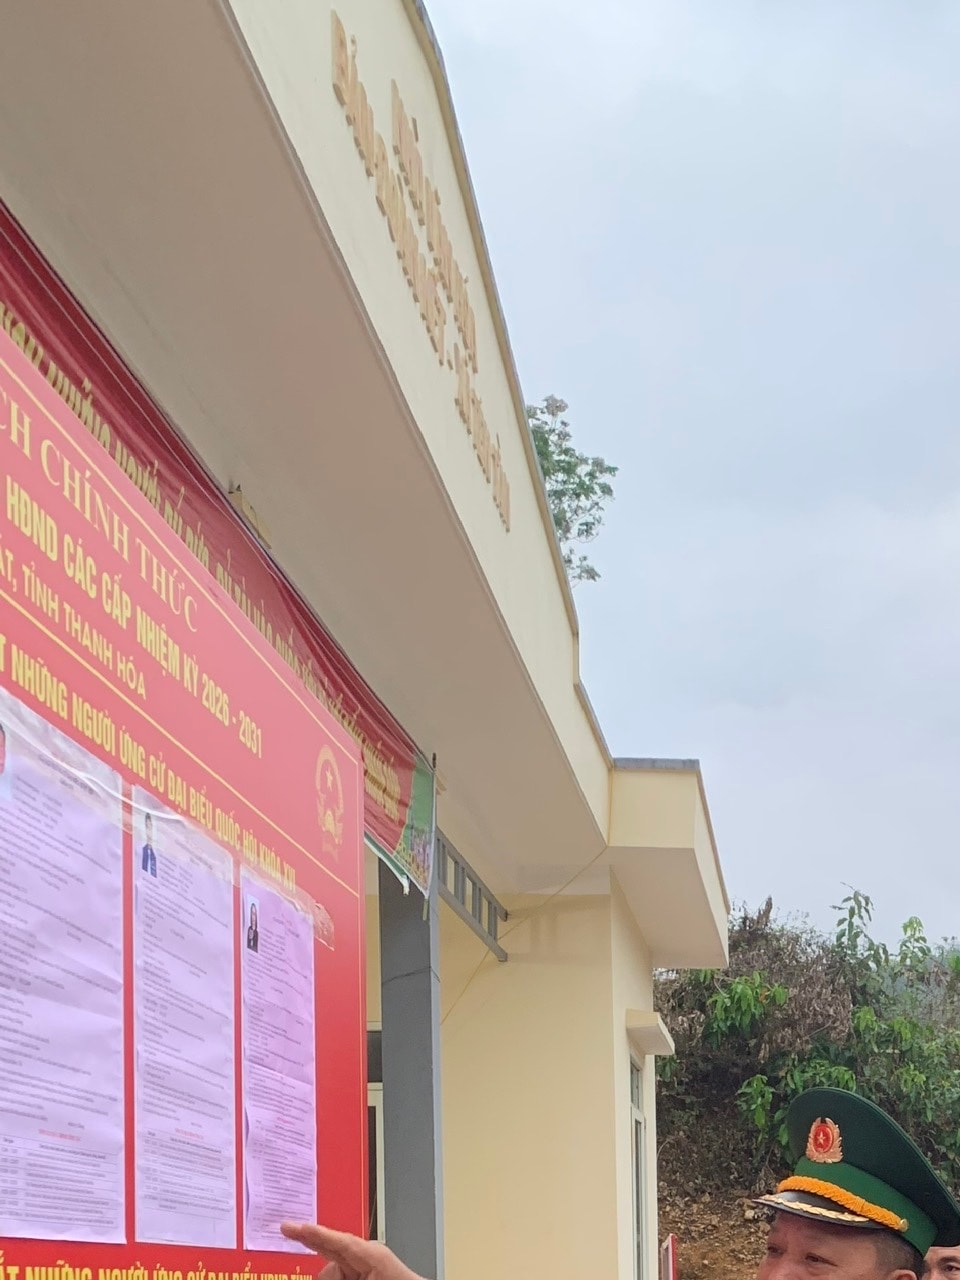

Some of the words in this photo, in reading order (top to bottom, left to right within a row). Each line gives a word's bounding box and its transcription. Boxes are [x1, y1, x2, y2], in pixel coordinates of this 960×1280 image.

[7, 474, 59, 562] HĐND
[63, 533, 97, 600] CÁC
[102, 571, 132, 630] CẤP
[136, 604, 181, 681] NHIỆM
[183, 653, 200, 698] KỲ
[202, 672, 230, 727] 2026
[239, 709, 263, 759] 2031
[22, 560, 59, 624] TỈNH
[63, 601, 113, 671] THANH
[117, 651, 147, 700] HÓA
[41, 438, 130, 564] CHÍNH
[134, 537, 198, 633] THỨC
[12, 643, 68, 720] NHỮNG
[72, 691, 116, 757] NGƯỜI
[120, 724, 146, 780] ỨNG
[150, 752, 166, 794] CỬ
[168, 768, 188, 814] ĐẠI
[190, 784, 213, 831] BIỂU
[216, 808, 241, 851] QUỐC
[242, 829, 258, 867] HỘI
[260, 842, 282, 882] KHÓA
